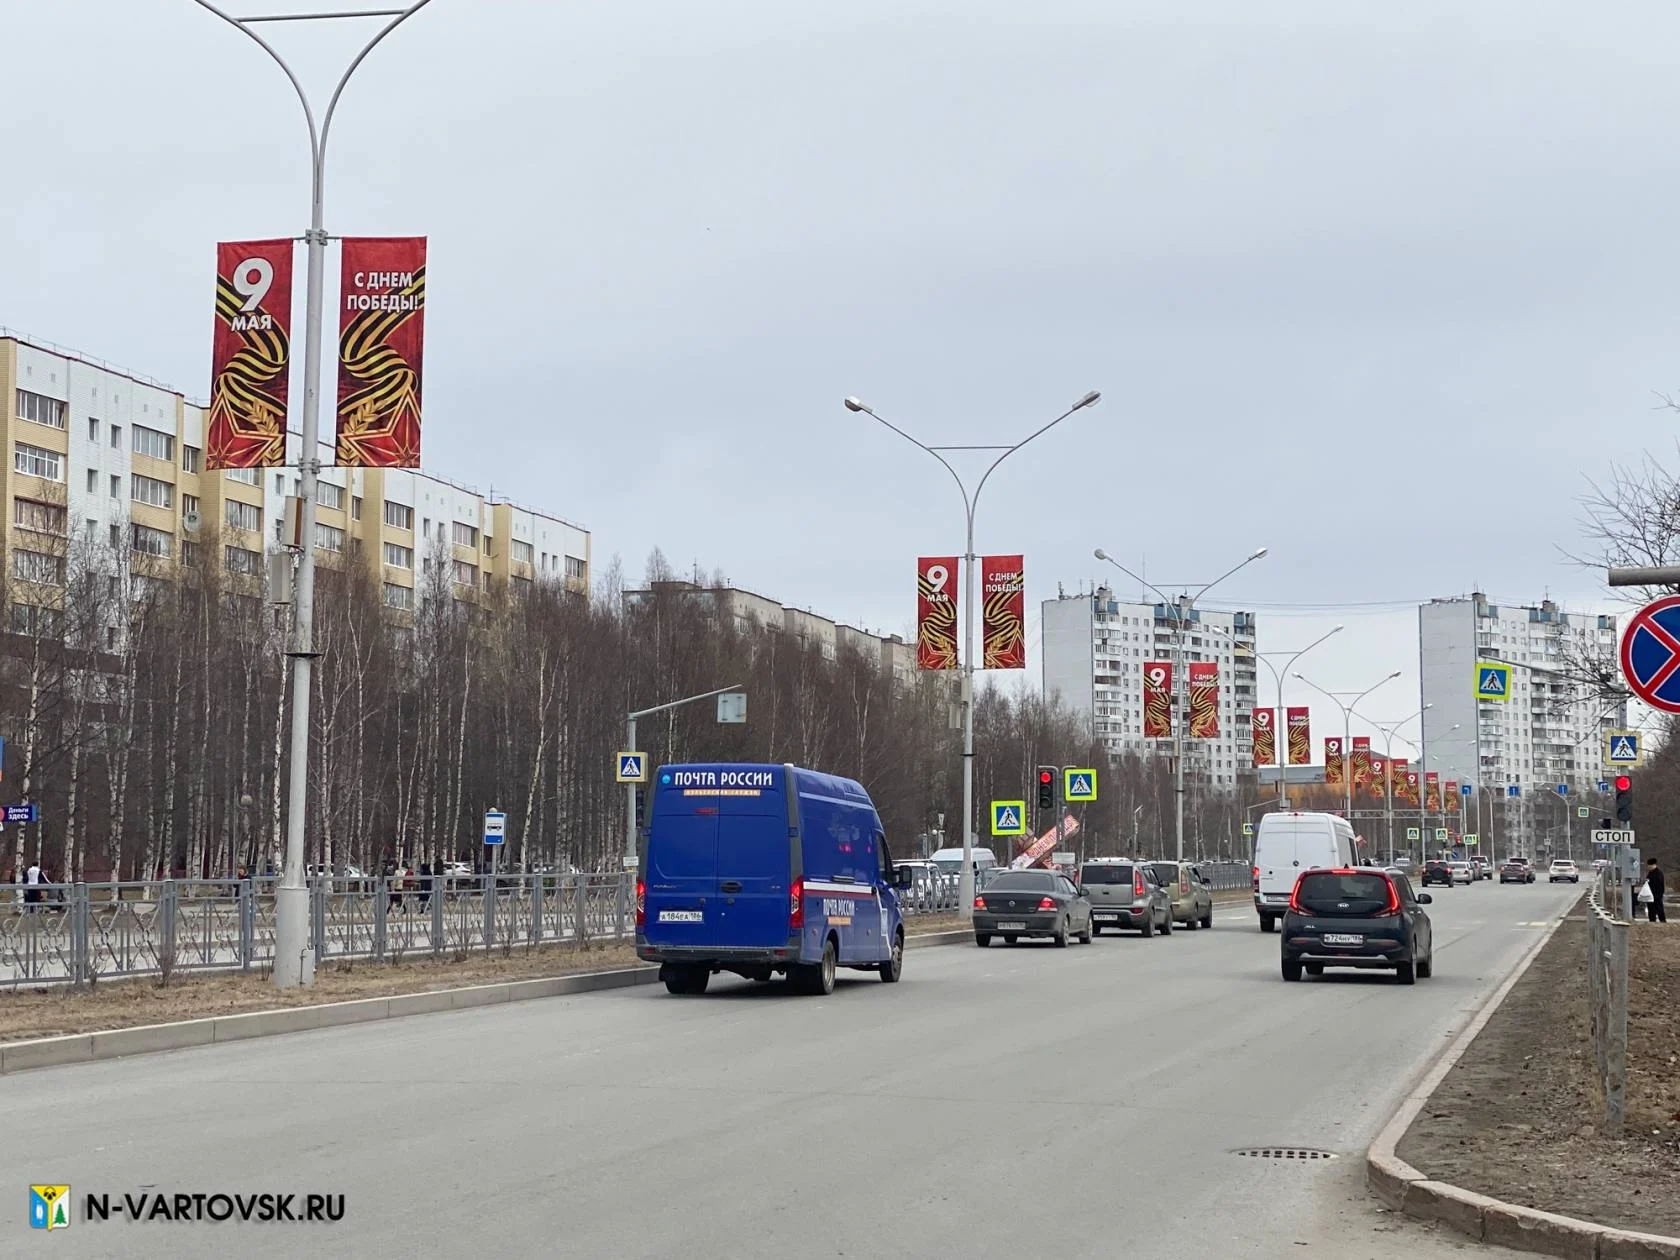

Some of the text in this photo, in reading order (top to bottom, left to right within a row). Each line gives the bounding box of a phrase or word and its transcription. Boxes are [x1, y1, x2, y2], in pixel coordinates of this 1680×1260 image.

[233, 257, 274, 312] 9
[354, 271, 414, 290] С ДНЕМ
[347, 294, 419, 312] ПОБЕДЫ!
[230, 314, 273, 332] МАЯ
[926, 564, 949, 593] 9
[988, 572, 1018, 582] С ДНЕМ
[985, 583, 1021, 593] ПОБЕДЫ!
[926, 593, 949, 603] МАЯ
[1150, 667, 1166, 687] 9
[1257, 711, 1270, 727] 9
[1328, 740, 1339, 752] 9
[1373, 761, 1382, 772] 9
[674, 772, 773, 786] ПОЧТА РОССИИ
[1408, 774, 1416, 785] 9
[1595, 831, 1631, 843] СТОП
